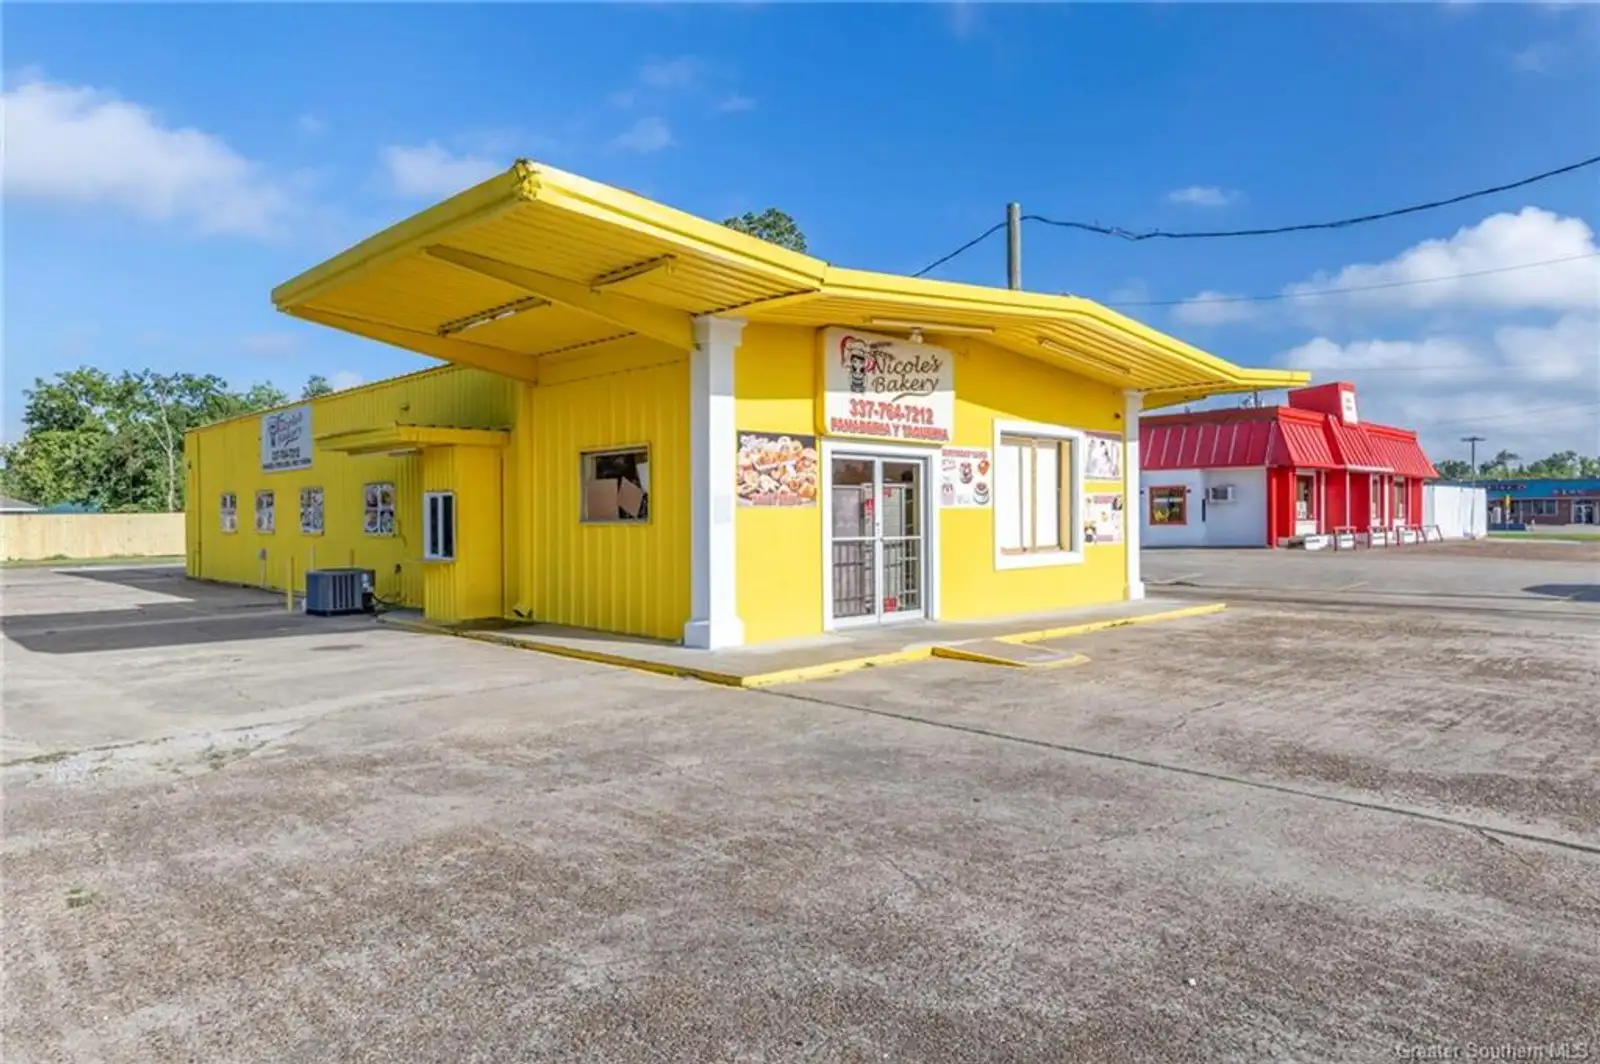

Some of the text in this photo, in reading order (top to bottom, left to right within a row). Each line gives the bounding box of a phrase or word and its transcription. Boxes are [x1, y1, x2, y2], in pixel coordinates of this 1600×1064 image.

[871, 351, 943, 375] Nicole's
[871, 374, 940, 401] Bakery
[849, 398, 934, 425] 337-764-7212
